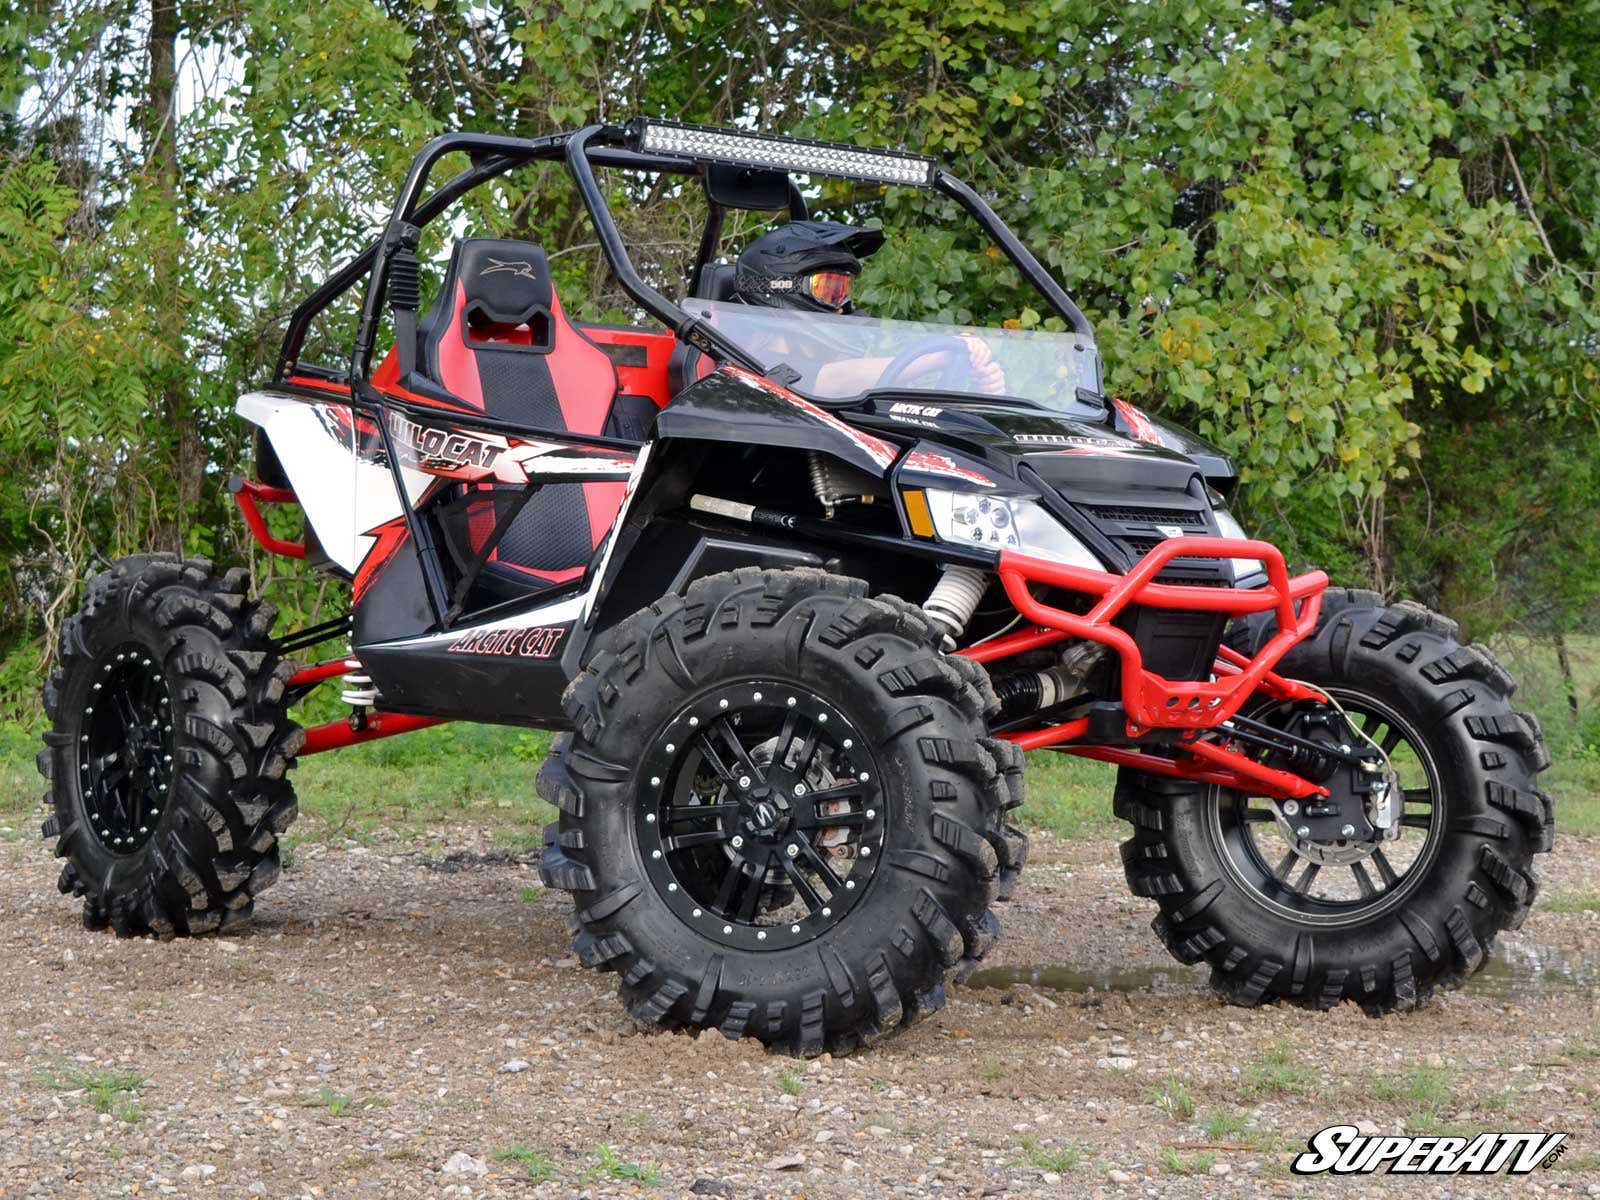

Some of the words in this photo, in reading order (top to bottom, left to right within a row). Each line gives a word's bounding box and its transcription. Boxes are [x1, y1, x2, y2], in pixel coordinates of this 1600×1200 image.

[770, 280, 793, 289] 509
[889, 402, 924, 416] ARCTIC
[921, 406, 944, 418] CAT
[388, 410, 508, 470] WILDCAT
[447, 627, 527, 656] ARCTIC
[519, 627, 565, 659] CAT
